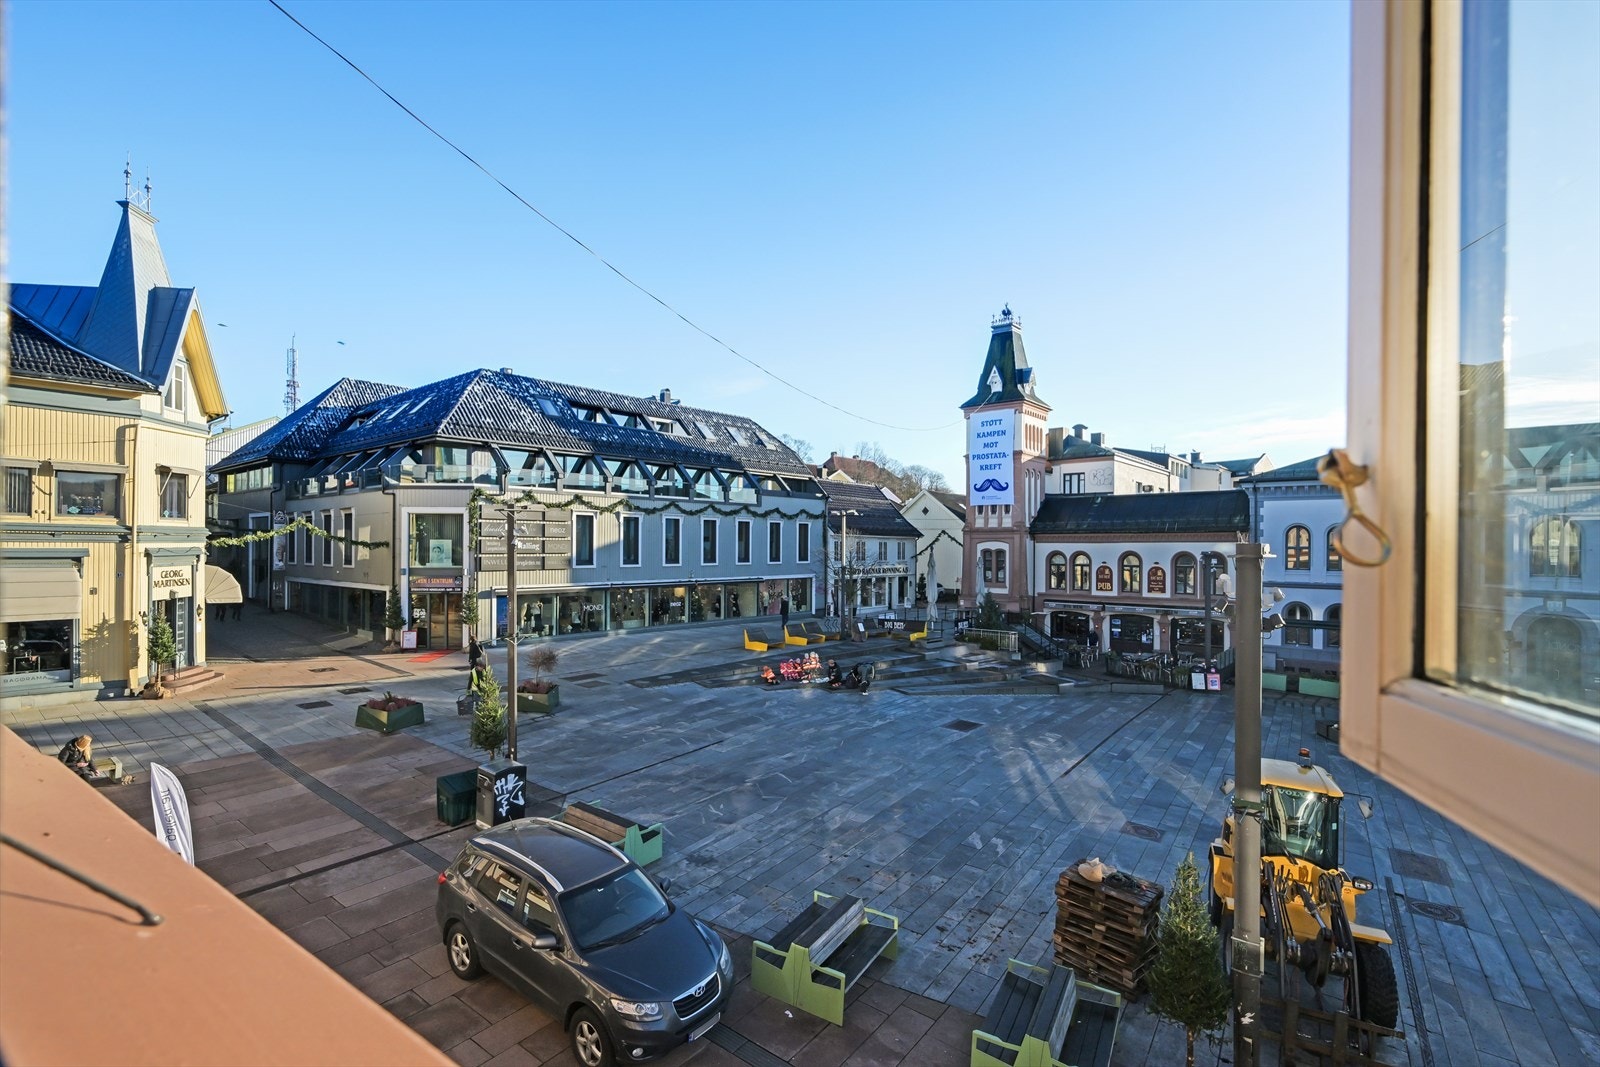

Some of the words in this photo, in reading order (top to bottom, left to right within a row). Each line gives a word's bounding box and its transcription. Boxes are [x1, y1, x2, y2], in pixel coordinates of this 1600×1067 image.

[980, 418, 1003, 428] STØTT
[976, 430, 1006, 438] KAMPEN
[972, 452, 1010, 460] PROSTATA-
[160, 570, 184, 578] GEORG
[153, 578, 191, 588] MARTINSEN
[1277, 788, 1309, 798] VOLV
